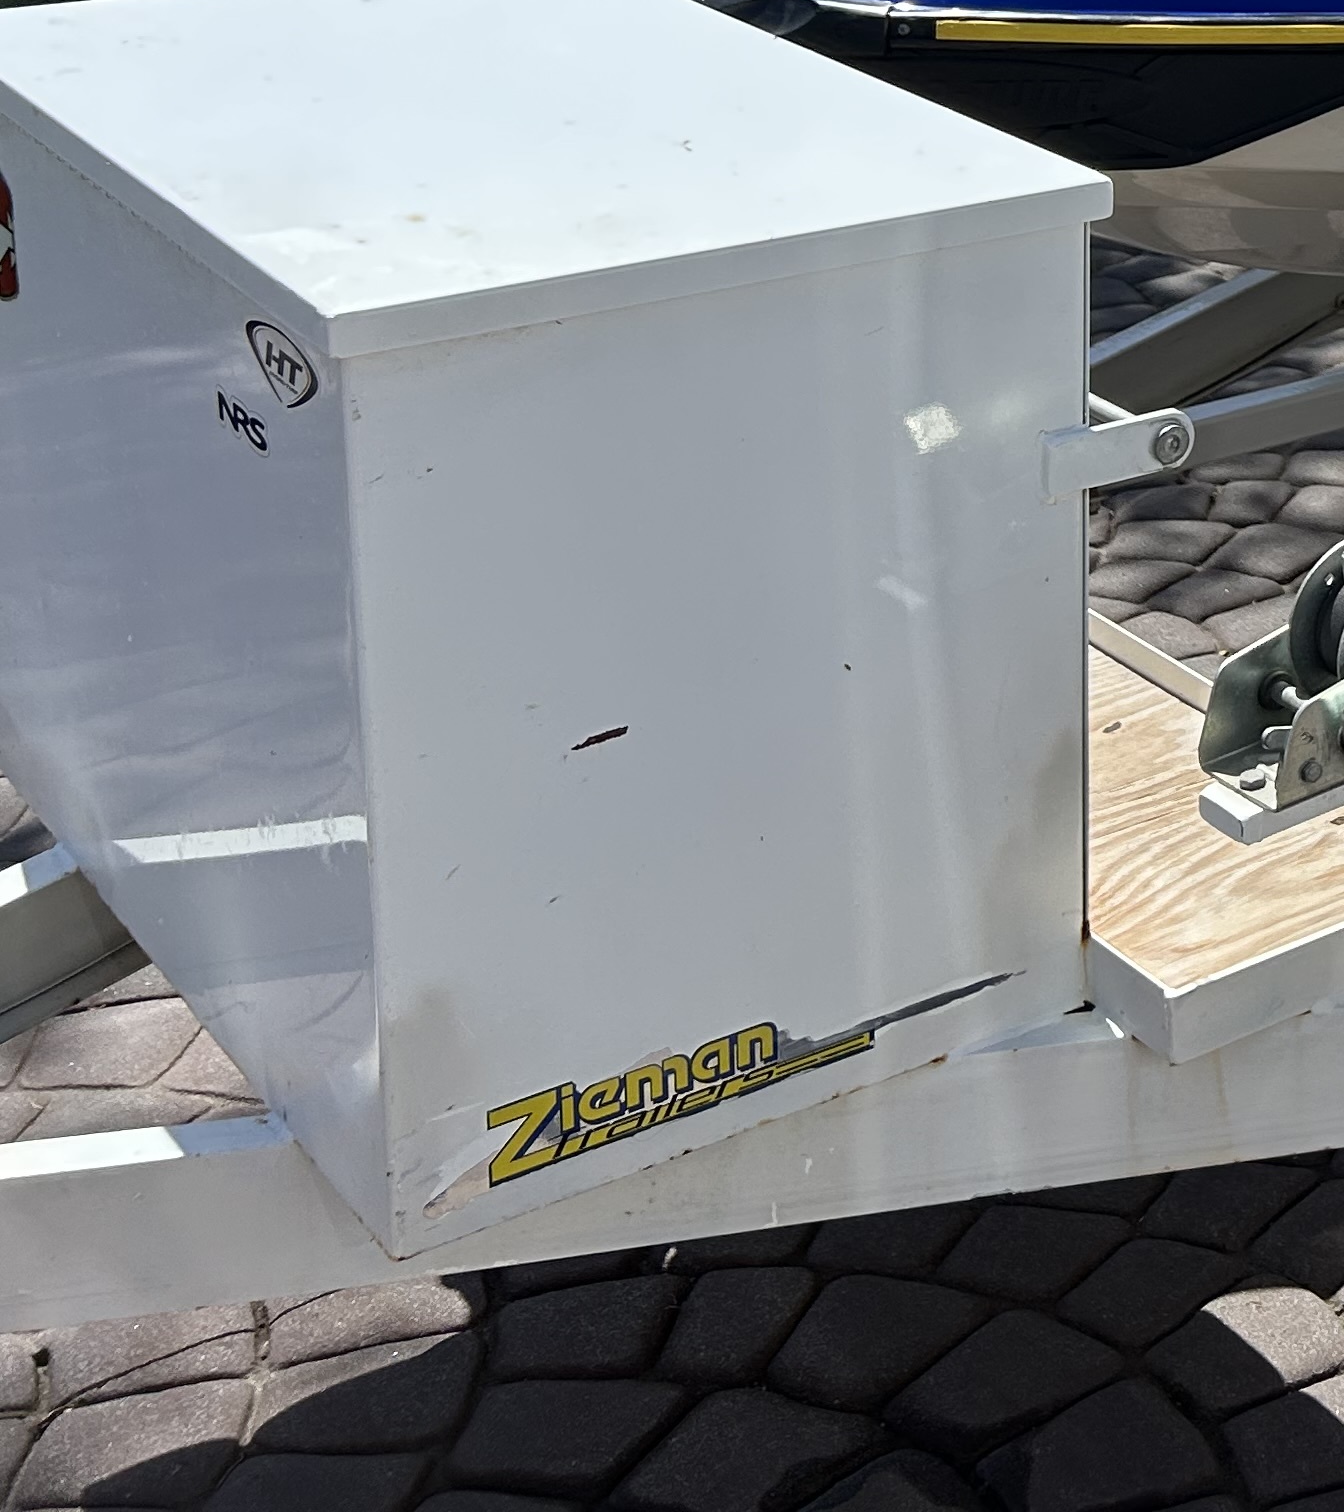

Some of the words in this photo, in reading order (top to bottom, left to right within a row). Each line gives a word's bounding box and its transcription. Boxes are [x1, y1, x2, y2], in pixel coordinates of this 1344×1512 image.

[265, 340, 303, 387] HT
[217, 390, 267, 452] NRS
[486, 1020, 778, 1188] Zieman
